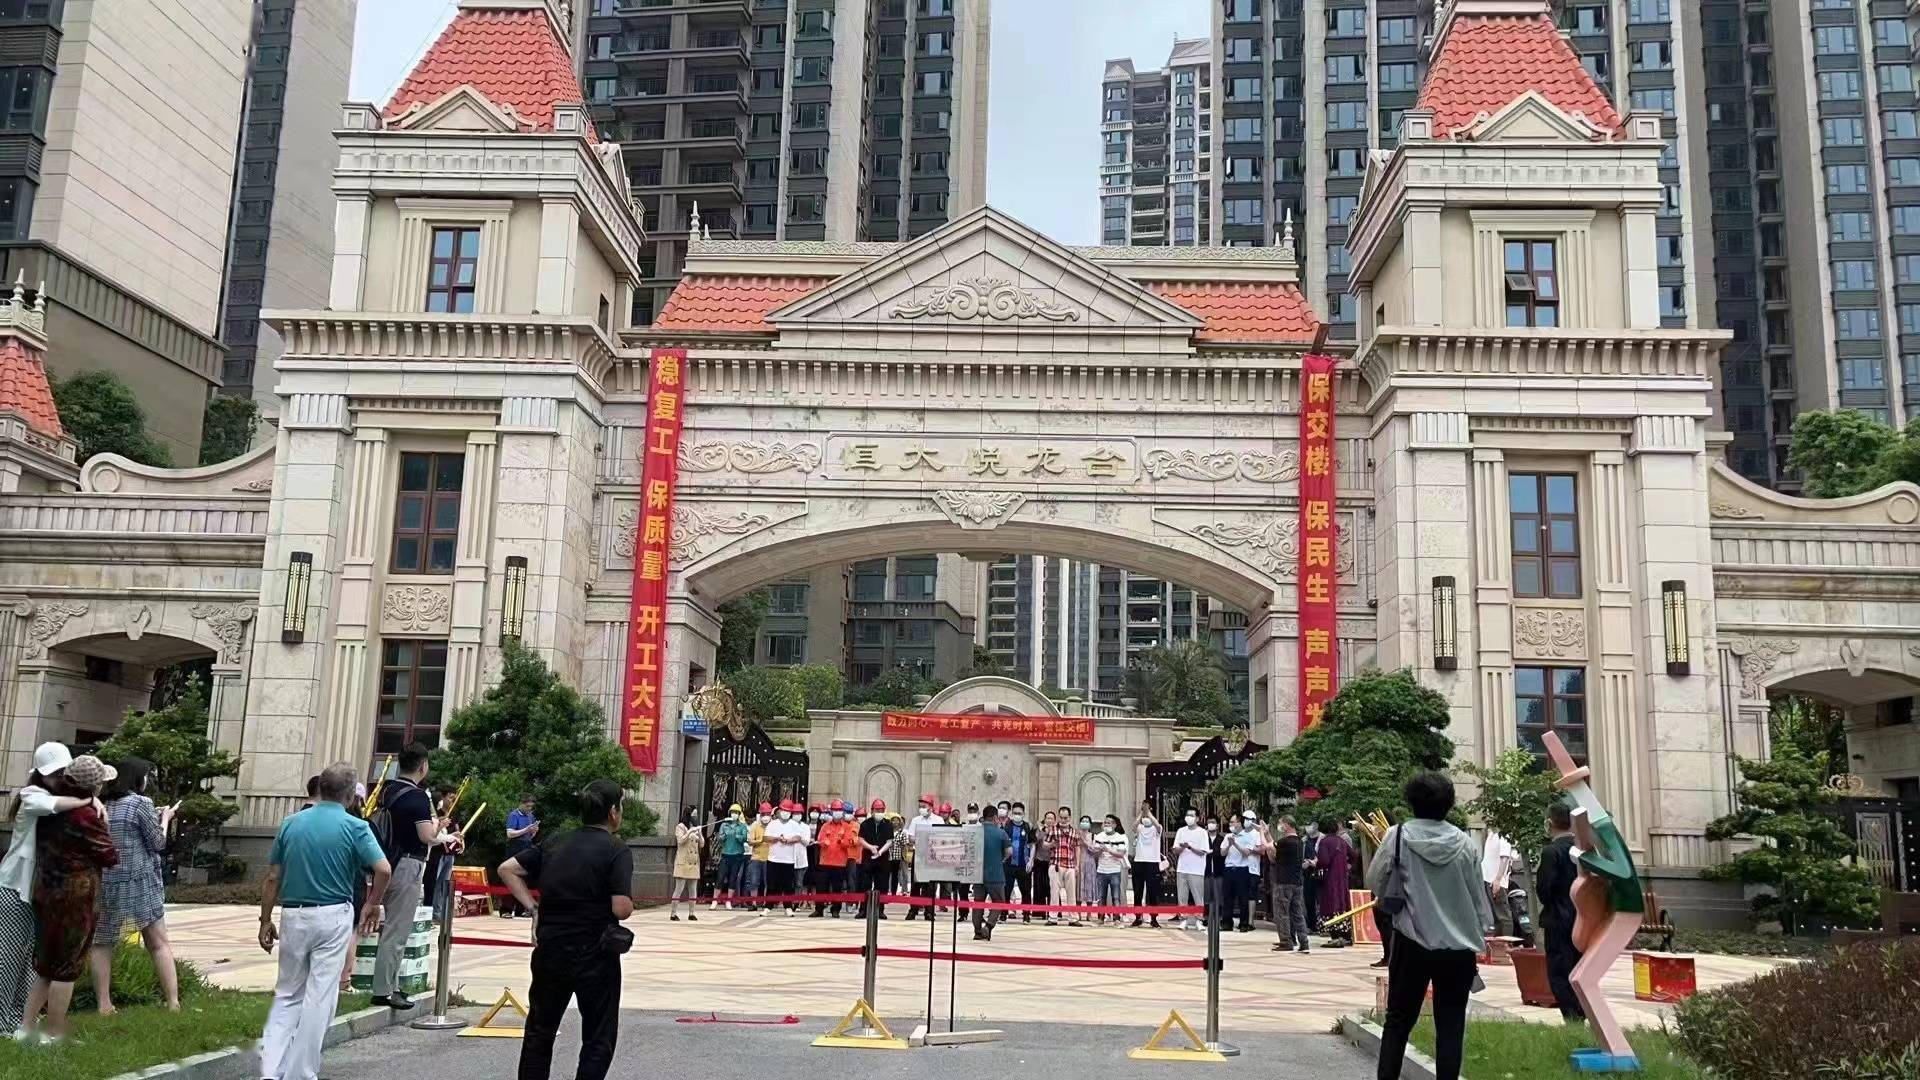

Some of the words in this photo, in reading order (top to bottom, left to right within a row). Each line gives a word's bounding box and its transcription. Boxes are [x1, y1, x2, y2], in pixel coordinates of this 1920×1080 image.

[650, 355, 680, 456] 稳复工
[1305, 373, 1330, 476] 保交楼
[840, 442, 1127, 477] 恒大悦龙台
[639, 478, 670, 581] 保质量
[1305, 499, 1330, 604] 保民生
[628, 604, 660, 748] 开工大吉
